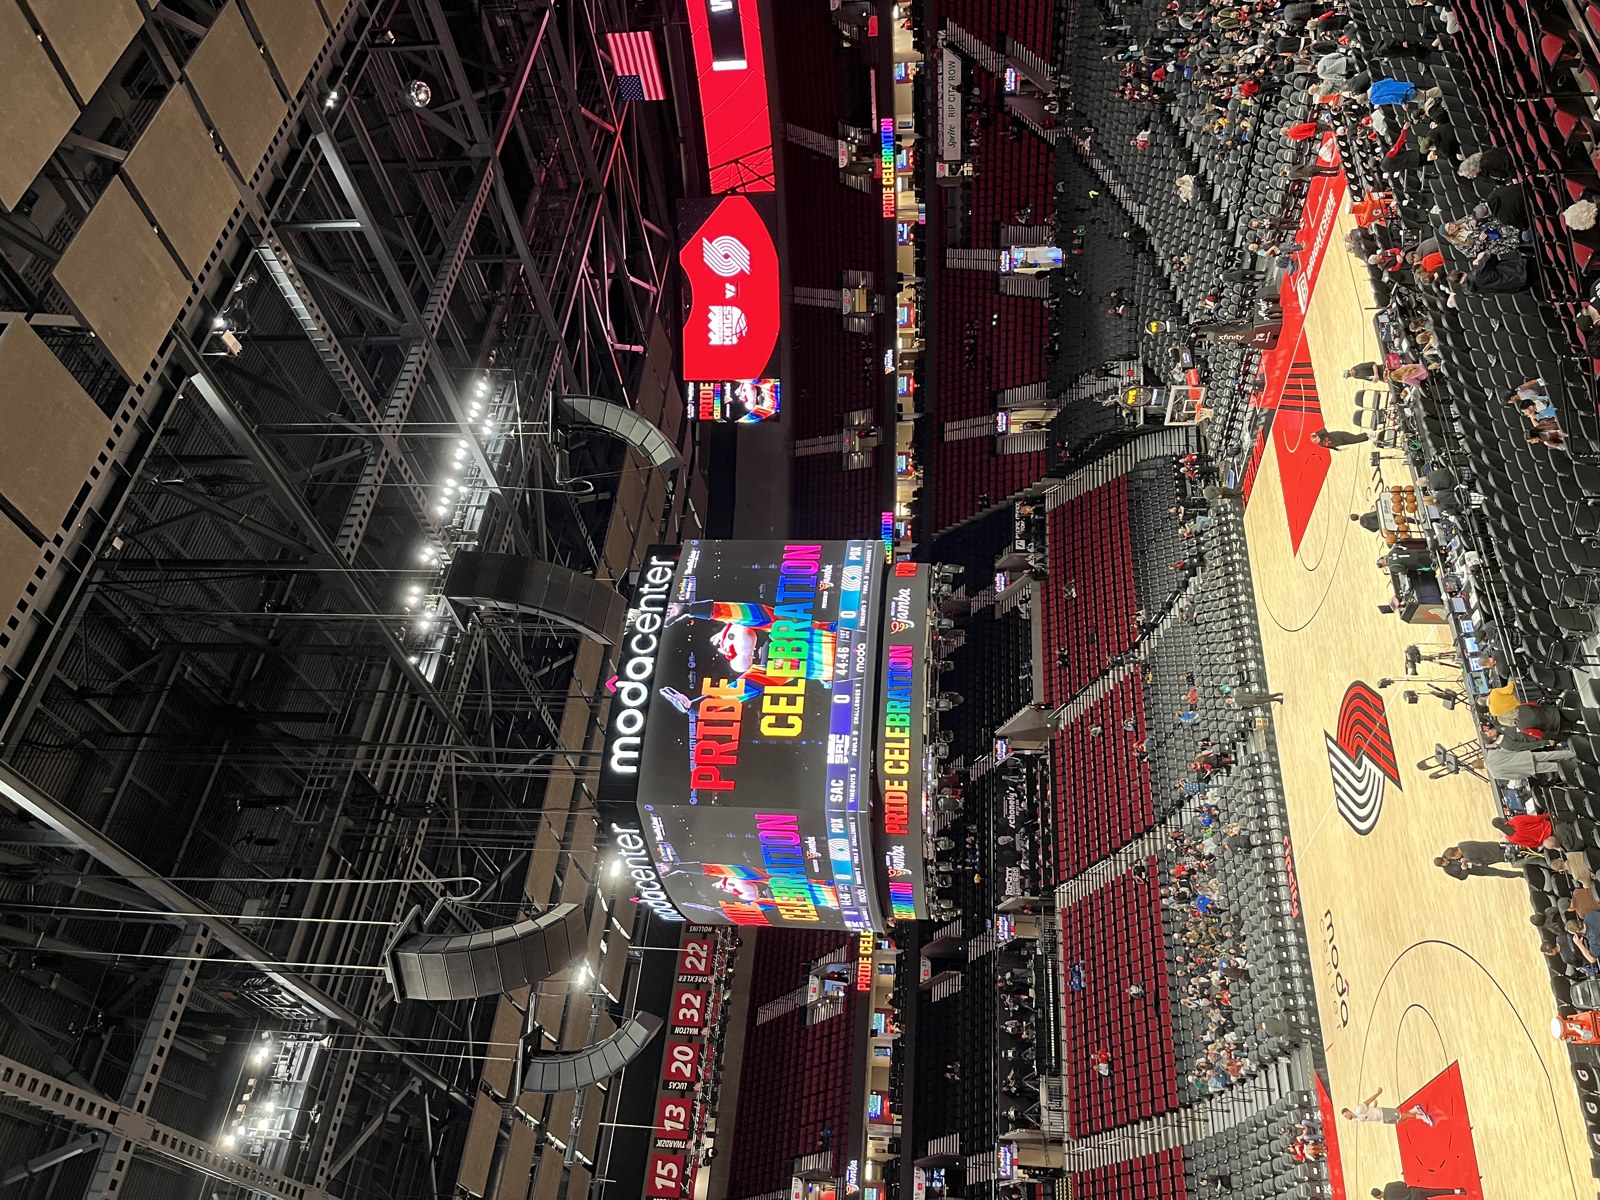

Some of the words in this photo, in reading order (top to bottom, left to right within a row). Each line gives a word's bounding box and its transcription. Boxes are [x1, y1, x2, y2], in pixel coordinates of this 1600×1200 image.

[948, 82, 956, 102] CITY
[881, 118, 894, 185] CELEBRATION
[948, 125, 956, 148] Sprite
[882, 187, 895, 218] PRIDE
[1306, 188, 1334, 280] BRIGHTSIDE
[700, 382, 714, 420] PRIDE
[849, 546, 862, 560] PDX
[864, 549, 872, 573] CHALLENGES
[840, 610, 856, 618] 0
[892, 587, 915, 628] jamba
[760, 545, 822, 737] CELEBRATION
[836, 647, 850, 676] 44:46
[855, 643, 866, 673] moda
[833, 694, 850, 704] 0
[853, 689, 861, 724] CHALLENGES
[884, 645, 913, 774] CELEBRATION
[690, 678, 746, 791] PRIDE
[830, 779, 844, 802] SAC
[884, 779, 908, 834] PRIDE
[1006, 786, 1017, 828] schonely's
[830, 818, 844, 833] PDX
[754, 814, 820, 921] CELEBRATION
[887, 844, 912, 874] jamba
[684, 942, 708, 971] 22
[1324, 909, 1348, 1028] moda
[857, 957, 872, 991] PRIDE
[1320, 919, 1341, 1030] center
[678, 993, 701, 1022] 32
[671, 1046, 694, 1077] 20
[1577, 1070, 1589, 1081] G
[668, 1081, 688, 1090] LUCAS
[664, 1104, 686, 1131] 13
[1586, 1102, 1598, 1114] G
[656, 1139, 686, 1148] TWARDZIK
[655, 1160, 678, 1190] 15
